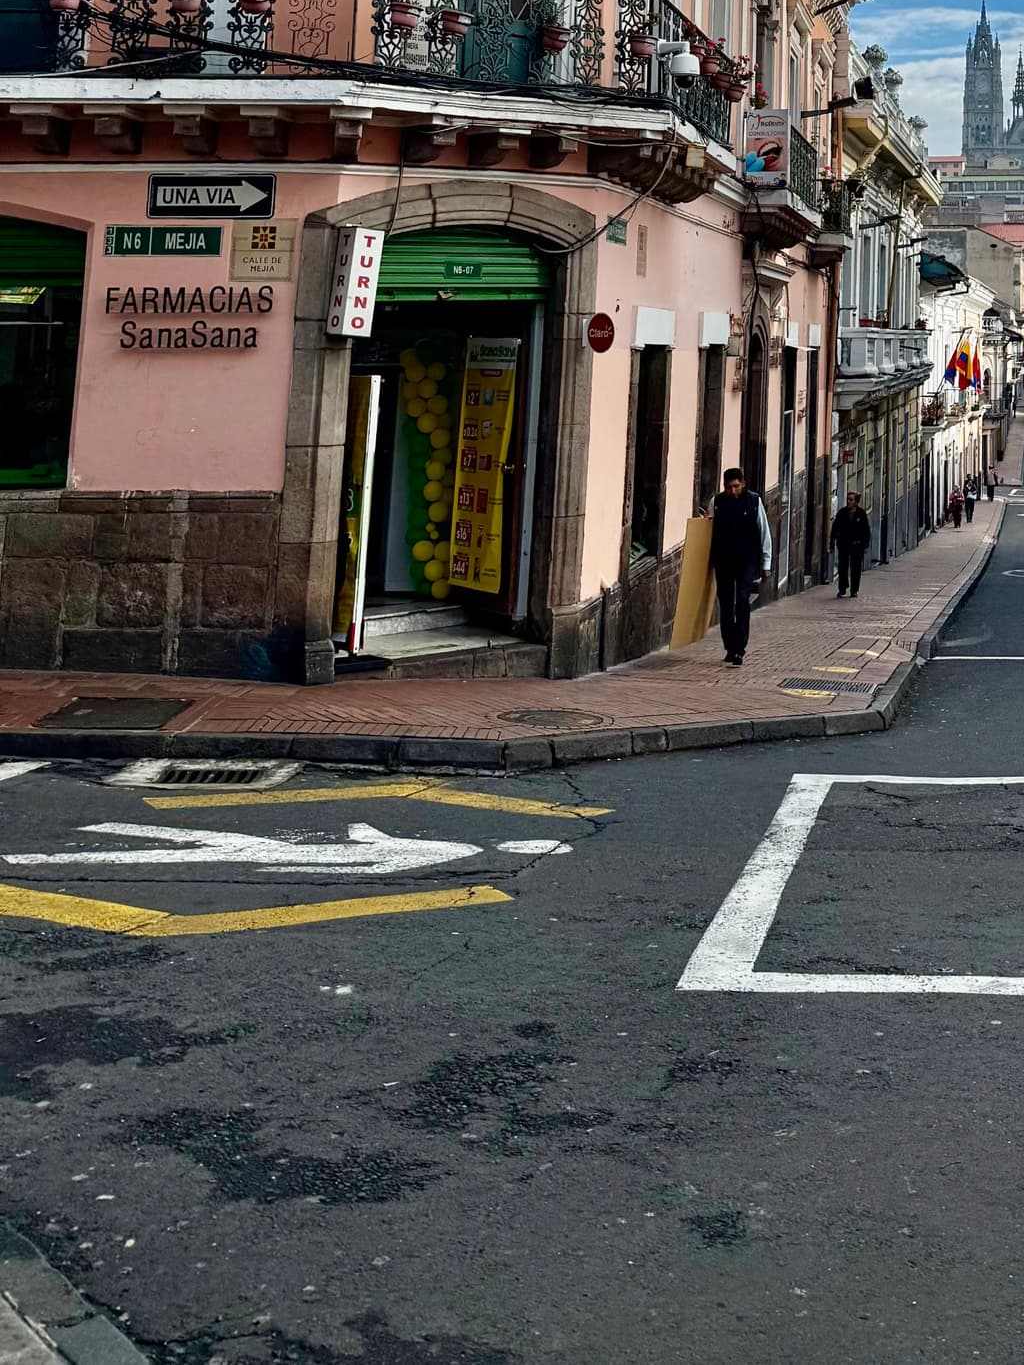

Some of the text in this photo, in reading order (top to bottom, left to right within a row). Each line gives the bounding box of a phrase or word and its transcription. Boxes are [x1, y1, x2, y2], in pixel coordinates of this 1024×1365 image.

[162, 188, 236, 204] UNA VIA
[165, 233, 206, 249] MEJIA
[243, 256, 268, 264] CALLE
[331, 235, 350, 328] TURNO
[351, 236, 376, 329] TURNO
[105, 285, 274, 314] FARMACIAS
[119, 320, 258, 348] SanaSana
[588, 328, 609, 338] Claro
